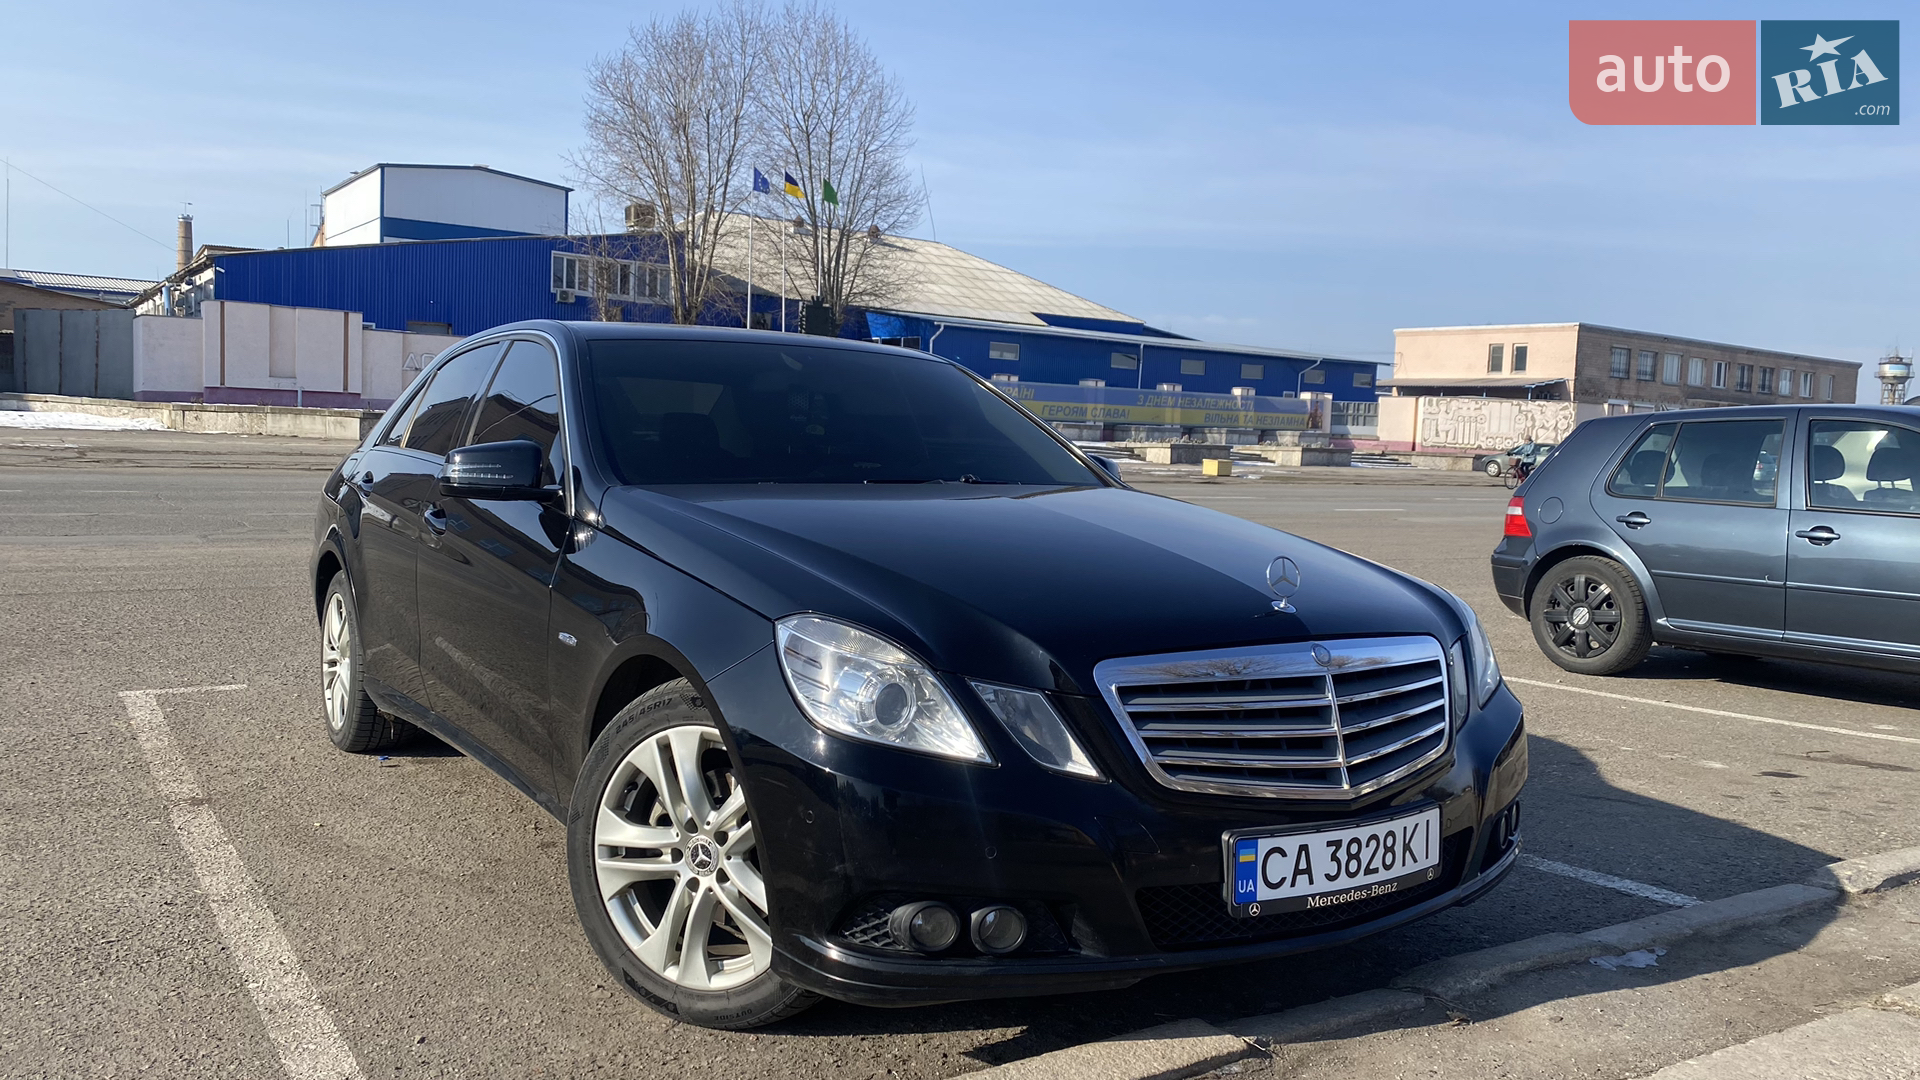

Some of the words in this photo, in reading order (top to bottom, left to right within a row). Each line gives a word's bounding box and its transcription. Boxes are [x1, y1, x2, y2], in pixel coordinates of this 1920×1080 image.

[1001, 385, 1035, 400] РАЇНІ
[1146, 395, 1175, 407] ДНЕМ
[1041, 404, 1088, 417] ГЕРОЯМ
[1090, 407, 1131, 419] СЛАВА!
[1204, 414, 1240, 425] ВІЛЬНА
[1243, 415, 1254, 425] ТА
[1256, 416, 1306, 427] НЕЗЛАМНА
[1238, 879, 1255, 893] UA
[1306, 882, 1398, 909] Mercedes-Benz
